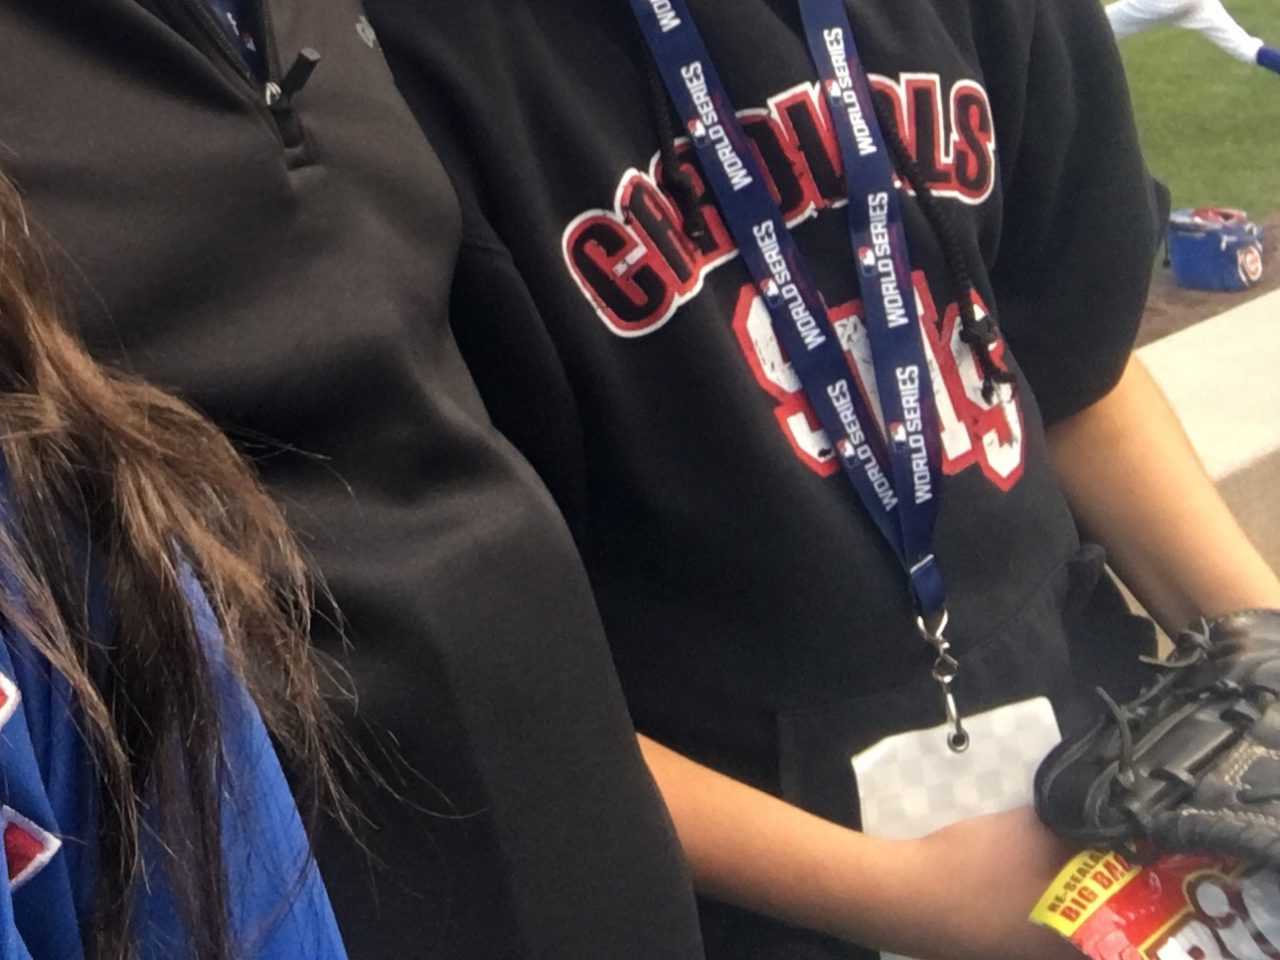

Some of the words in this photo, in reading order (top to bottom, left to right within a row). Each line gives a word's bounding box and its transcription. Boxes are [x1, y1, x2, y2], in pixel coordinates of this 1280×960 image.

[823, 27, 853, 90] SERIES
[680, 60, 718, 125] SERIES
[842, 89, 877, 156] WORLD
[708, 124, 753, 191] WORLD
[753, 219, 791, 286] SERIES
[868, 192, 891, 257] SERIES
[781, 284, 826, 350] WORLD
[878, 258, 909, 328] WORLD
[827, 379, 865, 449] SERIES
[895, 364, 922, 433] SERIES
[857, 443, 899, 512] WORLD
[908, 434, 933, 505] WORLD
[1059, 886, 1099, 922] BIG
